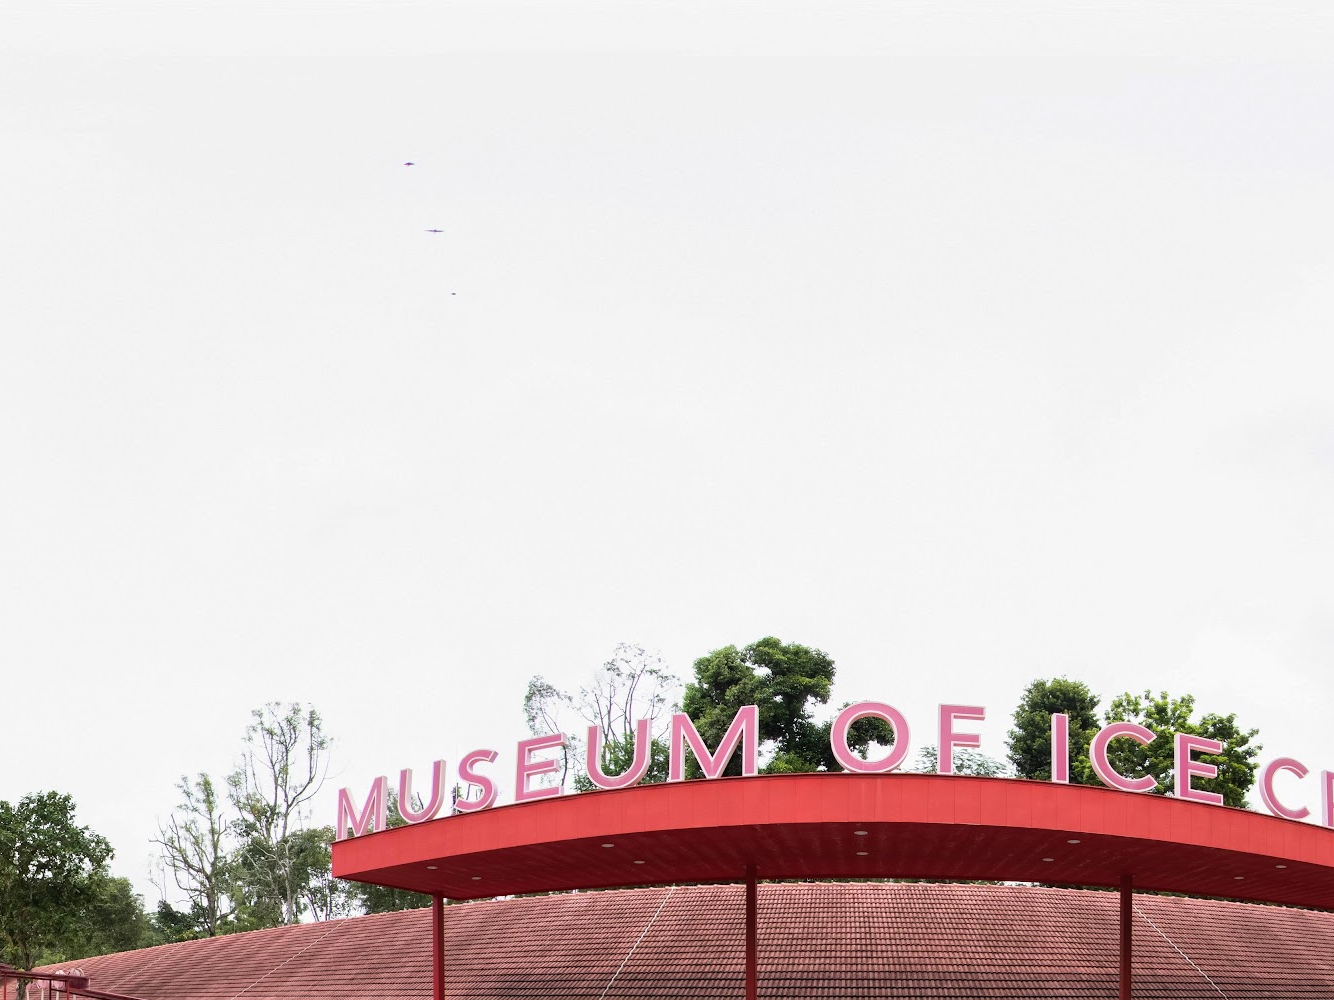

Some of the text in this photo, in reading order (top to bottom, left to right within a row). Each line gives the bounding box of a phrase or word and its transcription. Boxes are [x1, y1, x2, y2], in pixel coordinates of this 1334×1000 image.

[336, 704, 758, 840] MUSEUM
[830, 701, 986, 775] OF
[1051, 713, 1223, 805] ICE
